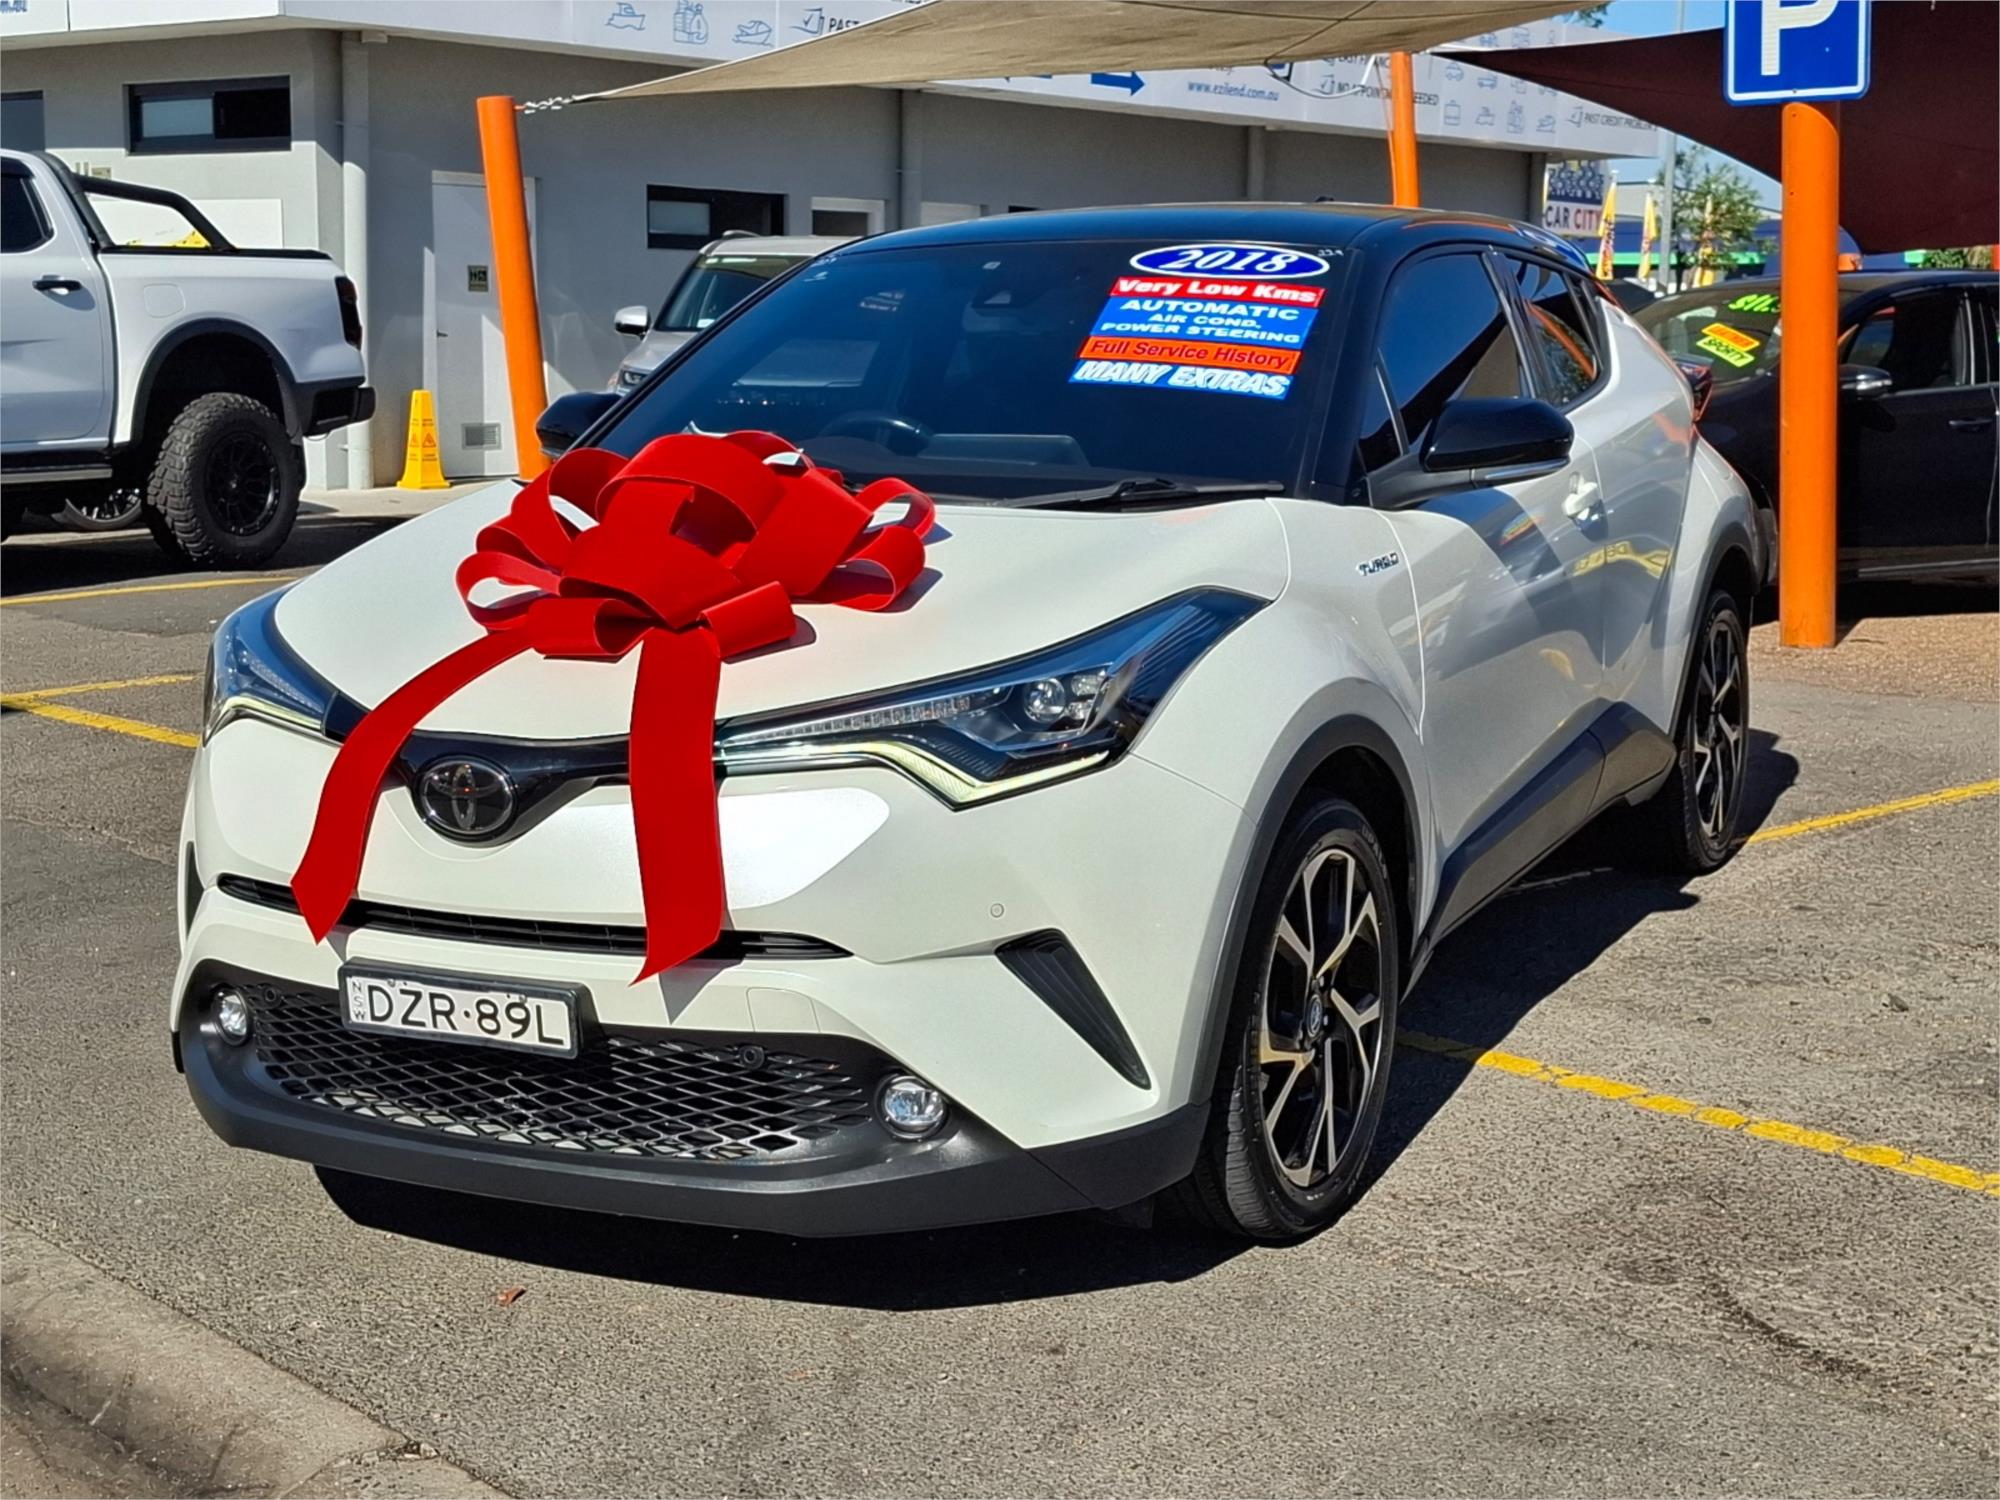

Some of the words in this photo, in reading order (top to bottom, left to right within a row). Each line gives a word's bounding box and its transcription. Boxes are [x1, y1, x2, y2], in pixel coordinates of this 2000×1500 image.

[1761, 0, 1839, 76] P
[1545, 205, 1570, 228] CAR
[1573, 208, 1602, 230] CITY
[1158, 249, 1300, 272] 2018
[1118, 280, 1182, 296] Very
[1187, 281, 1247, 297] Low
[1252, 285, 1317, 302] Kms
[1119, 299, 1301, 321] AUTOMATIC
[1149, 313, 1188, 324] AIR
[1193, 315, 1262, 329] COND.
[1101, 322, 1182, 335] POWER
[1186, 326, 1301, 344] STEERING
[1090, 340, 1127, 355] Full
[1132, 341, 1209, 360] Service
[1213, 347, 1289, 369] History
[1073, 361, 1172, 385] MANY
[1167, 365, 1292, 397] EXTRAS
